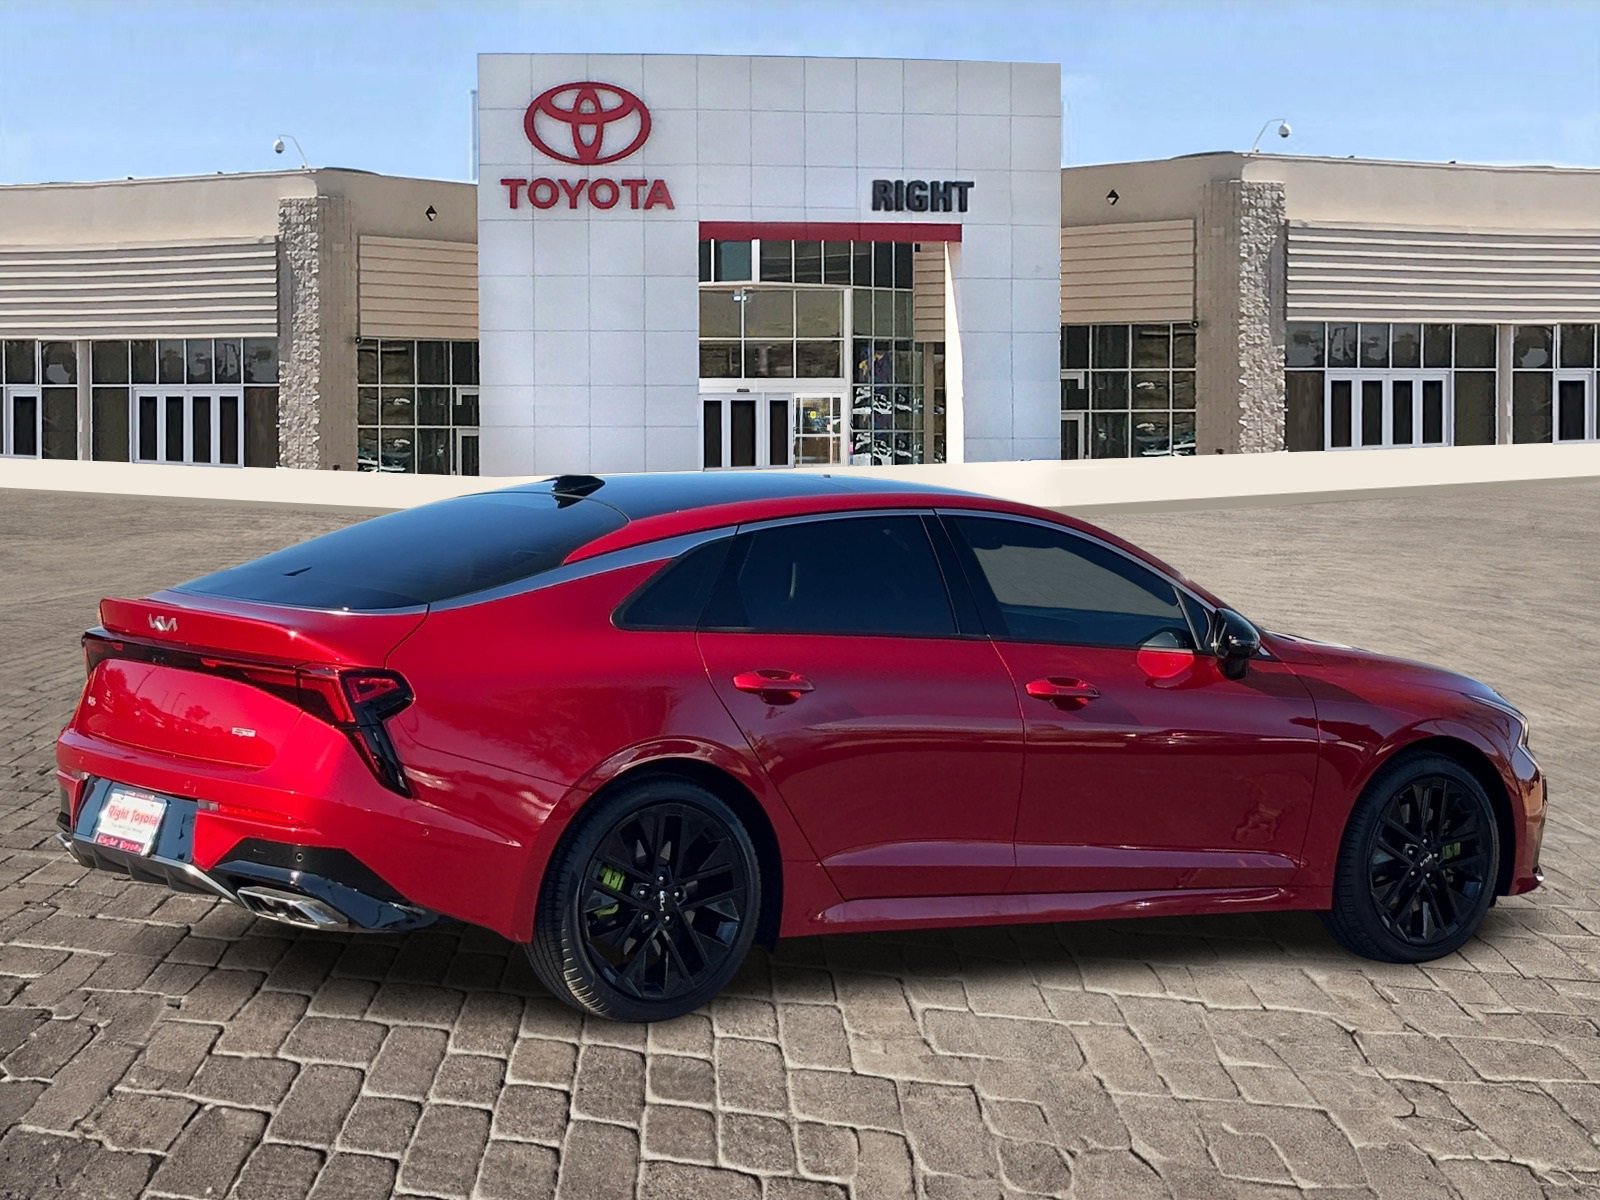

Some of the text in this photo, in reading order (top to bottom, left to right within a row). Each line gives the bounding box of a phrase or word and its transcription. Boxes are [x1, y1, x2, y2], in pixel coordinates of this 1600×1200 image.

[500, 178, 675, 209] TOYOTA
[872, 180, 975, 212] RIGHT
[108, 805, 158, 826] Right Toyota
